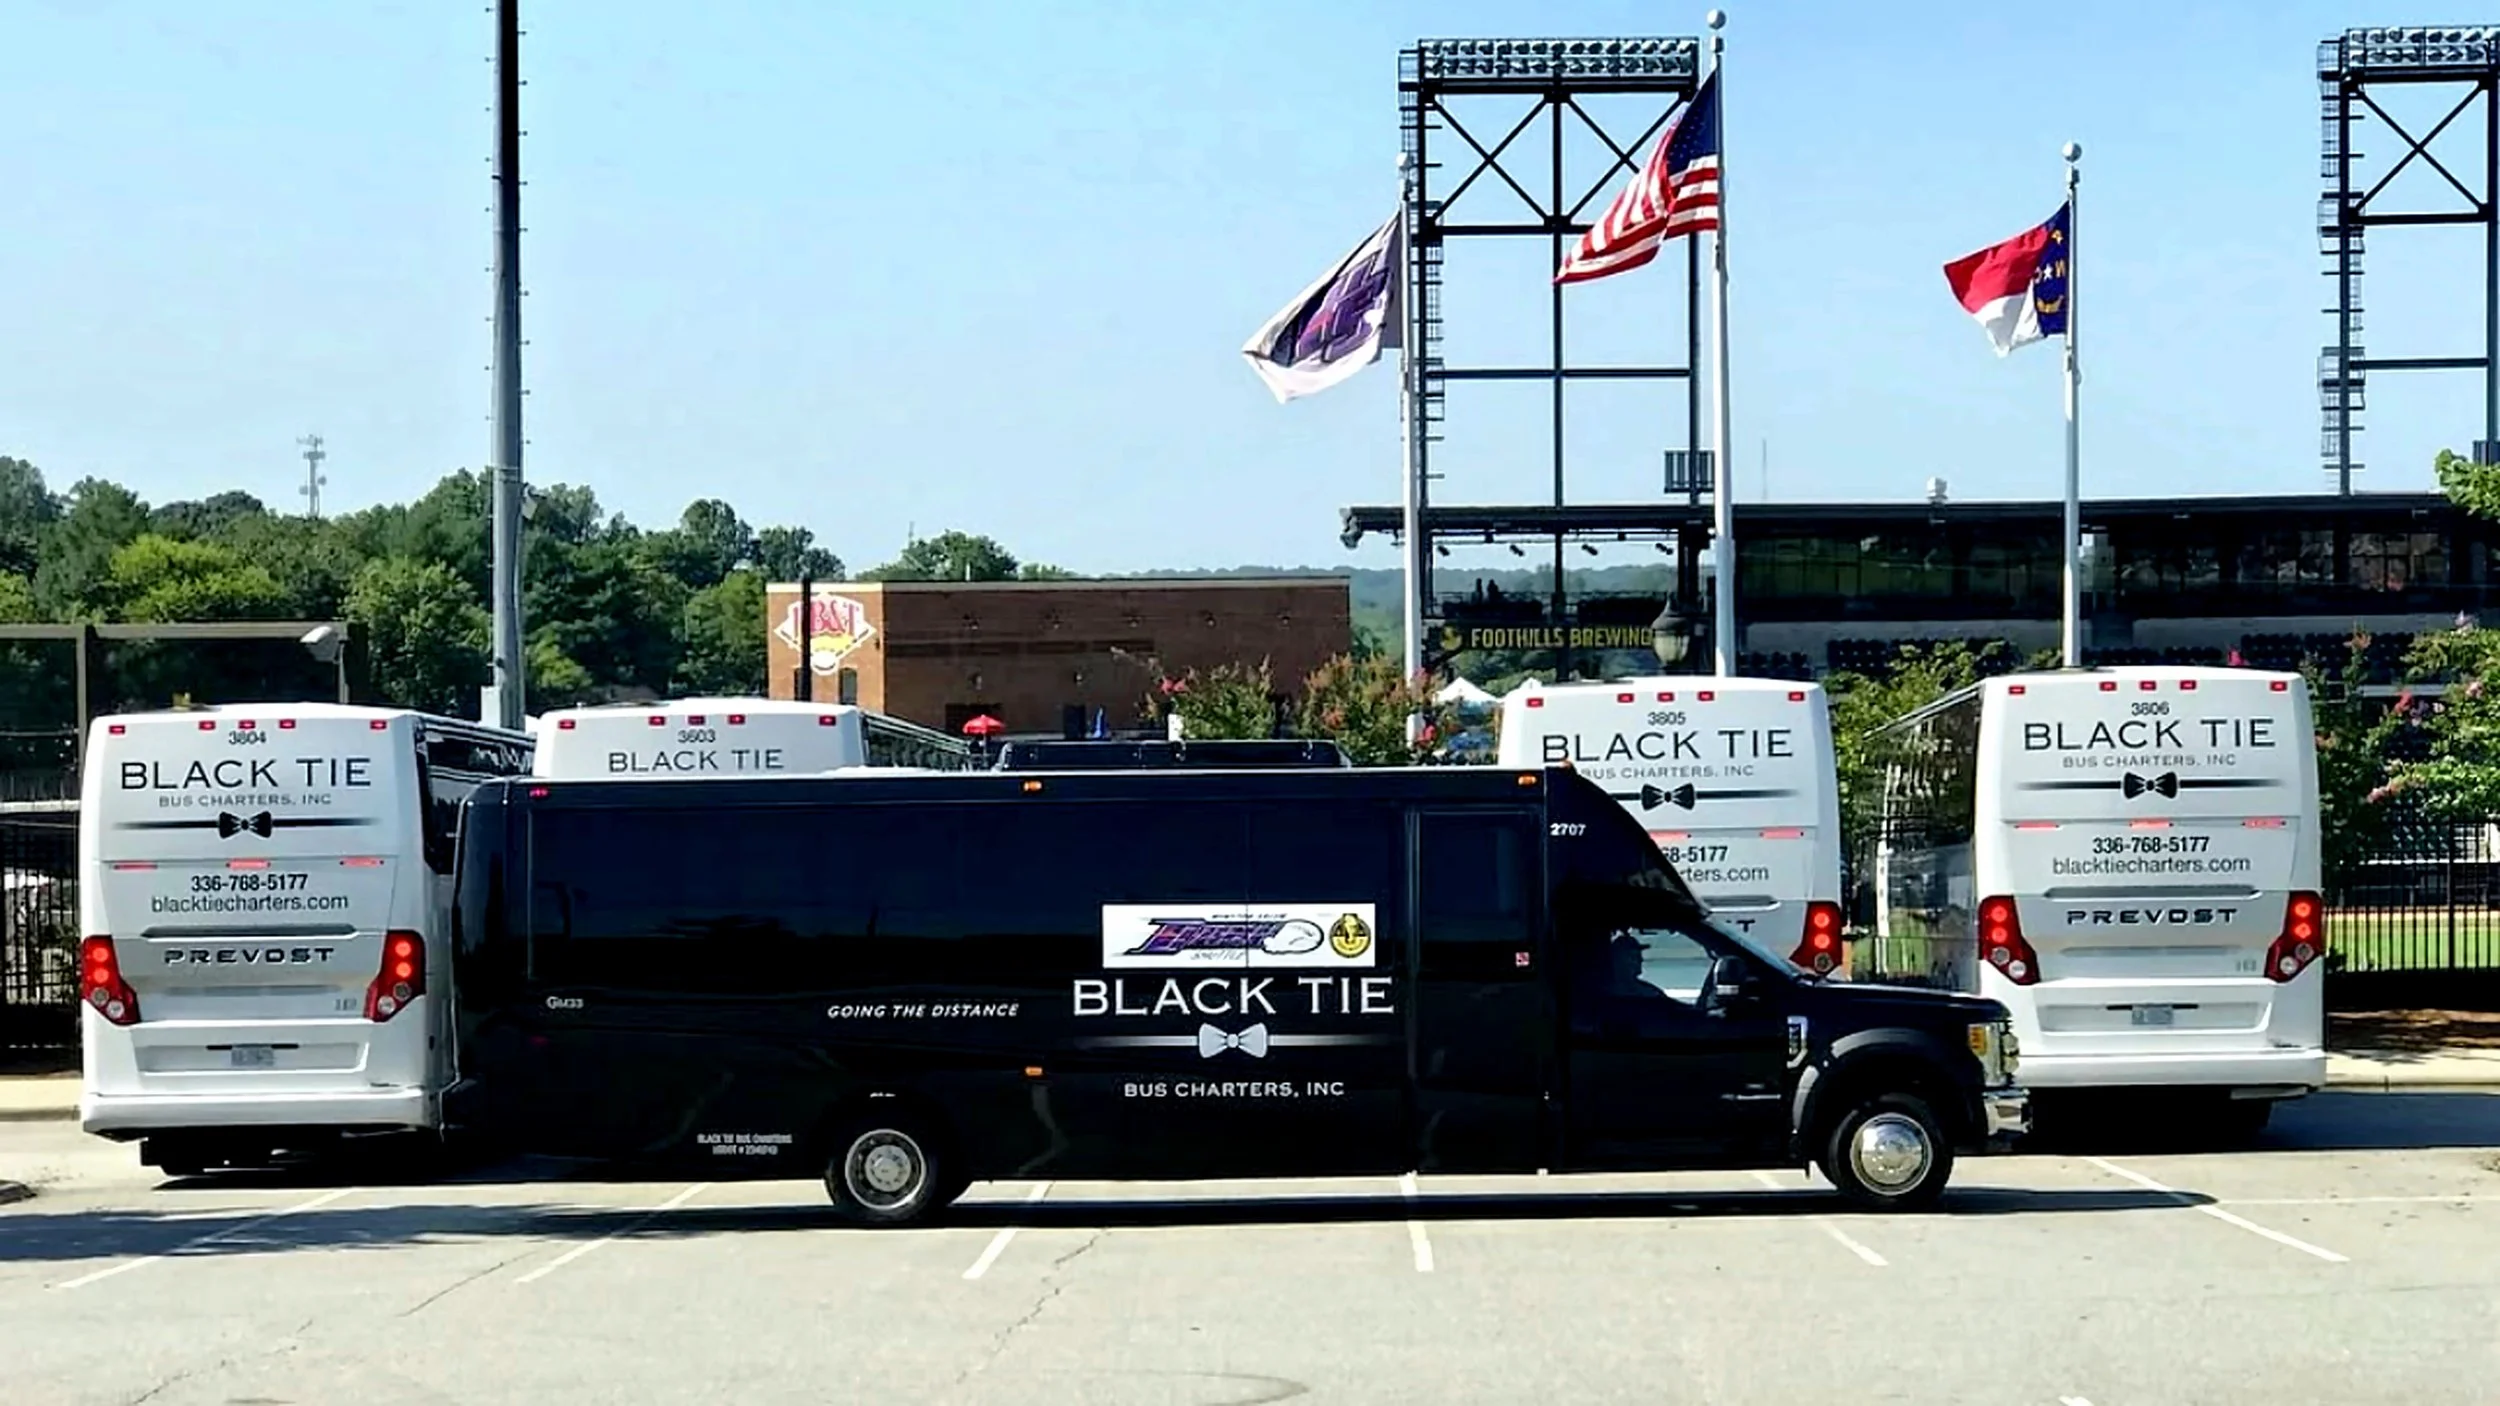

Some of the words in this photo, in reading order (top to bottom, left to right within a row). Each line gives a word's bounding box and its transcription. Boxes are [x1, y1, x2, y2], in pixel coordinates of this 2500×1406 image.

[1471, 627, 1565, 649] FOOTHILLS
[1569, 626, 1653, 648] BREWING
[2131, 701, 2170, 716] 3806
[1647, 711, 1687, 726] 3805
[228, 730, 267, 746] 3804
[677, 729, 717, 744] 3603
[2024, 719, 2183, 750] BLACK
[2200, 718, 2276, 748] TIE
[1543, 730, 1701, 763] BLACK
[1717, 729, 1794, 758] TIE
[608, 750, 719, 773] BLACK
[731, 749, 785, 770] TIE
[2063, 755, 2099, 769] BUS
[2206, 753, 2237, 766] INC
[121, 759, 279, 790] BLACK
[296, 757, 372, 787] TIE
[1724, 764, 1755, 777] INC
[158, 795, 194, 808] BUS
[302, 793, 332, 805] INC
[1549, 823, 1587, 836] 2707
[2092, 836, 2210, 854] 336-768-5177
[2053, 856, 2251, 875] blacktiecharters.com
[191, 874, 308, 892] 336-768-5177
[151, 894, 349, 913] blacktiecharters.com
[2066, 908, 2238, 925] PREVOST
[164, 947, 335, 965] PREVOST
[1073, 977, 1277, 1016] BLACK
[1298, 976, 1395, 1014] TIE
[828, 1004, 887, 1018] GOING
[892, 1004, 926, 1018] THE
[932, 1003, 1020, 1018] DISTANCE
[1124, 1082, 1168, 1097] BUS
[1174, 1081, 1300, 1098] CHARTERS,
[1306, 1081, 1345, 1097] INC
